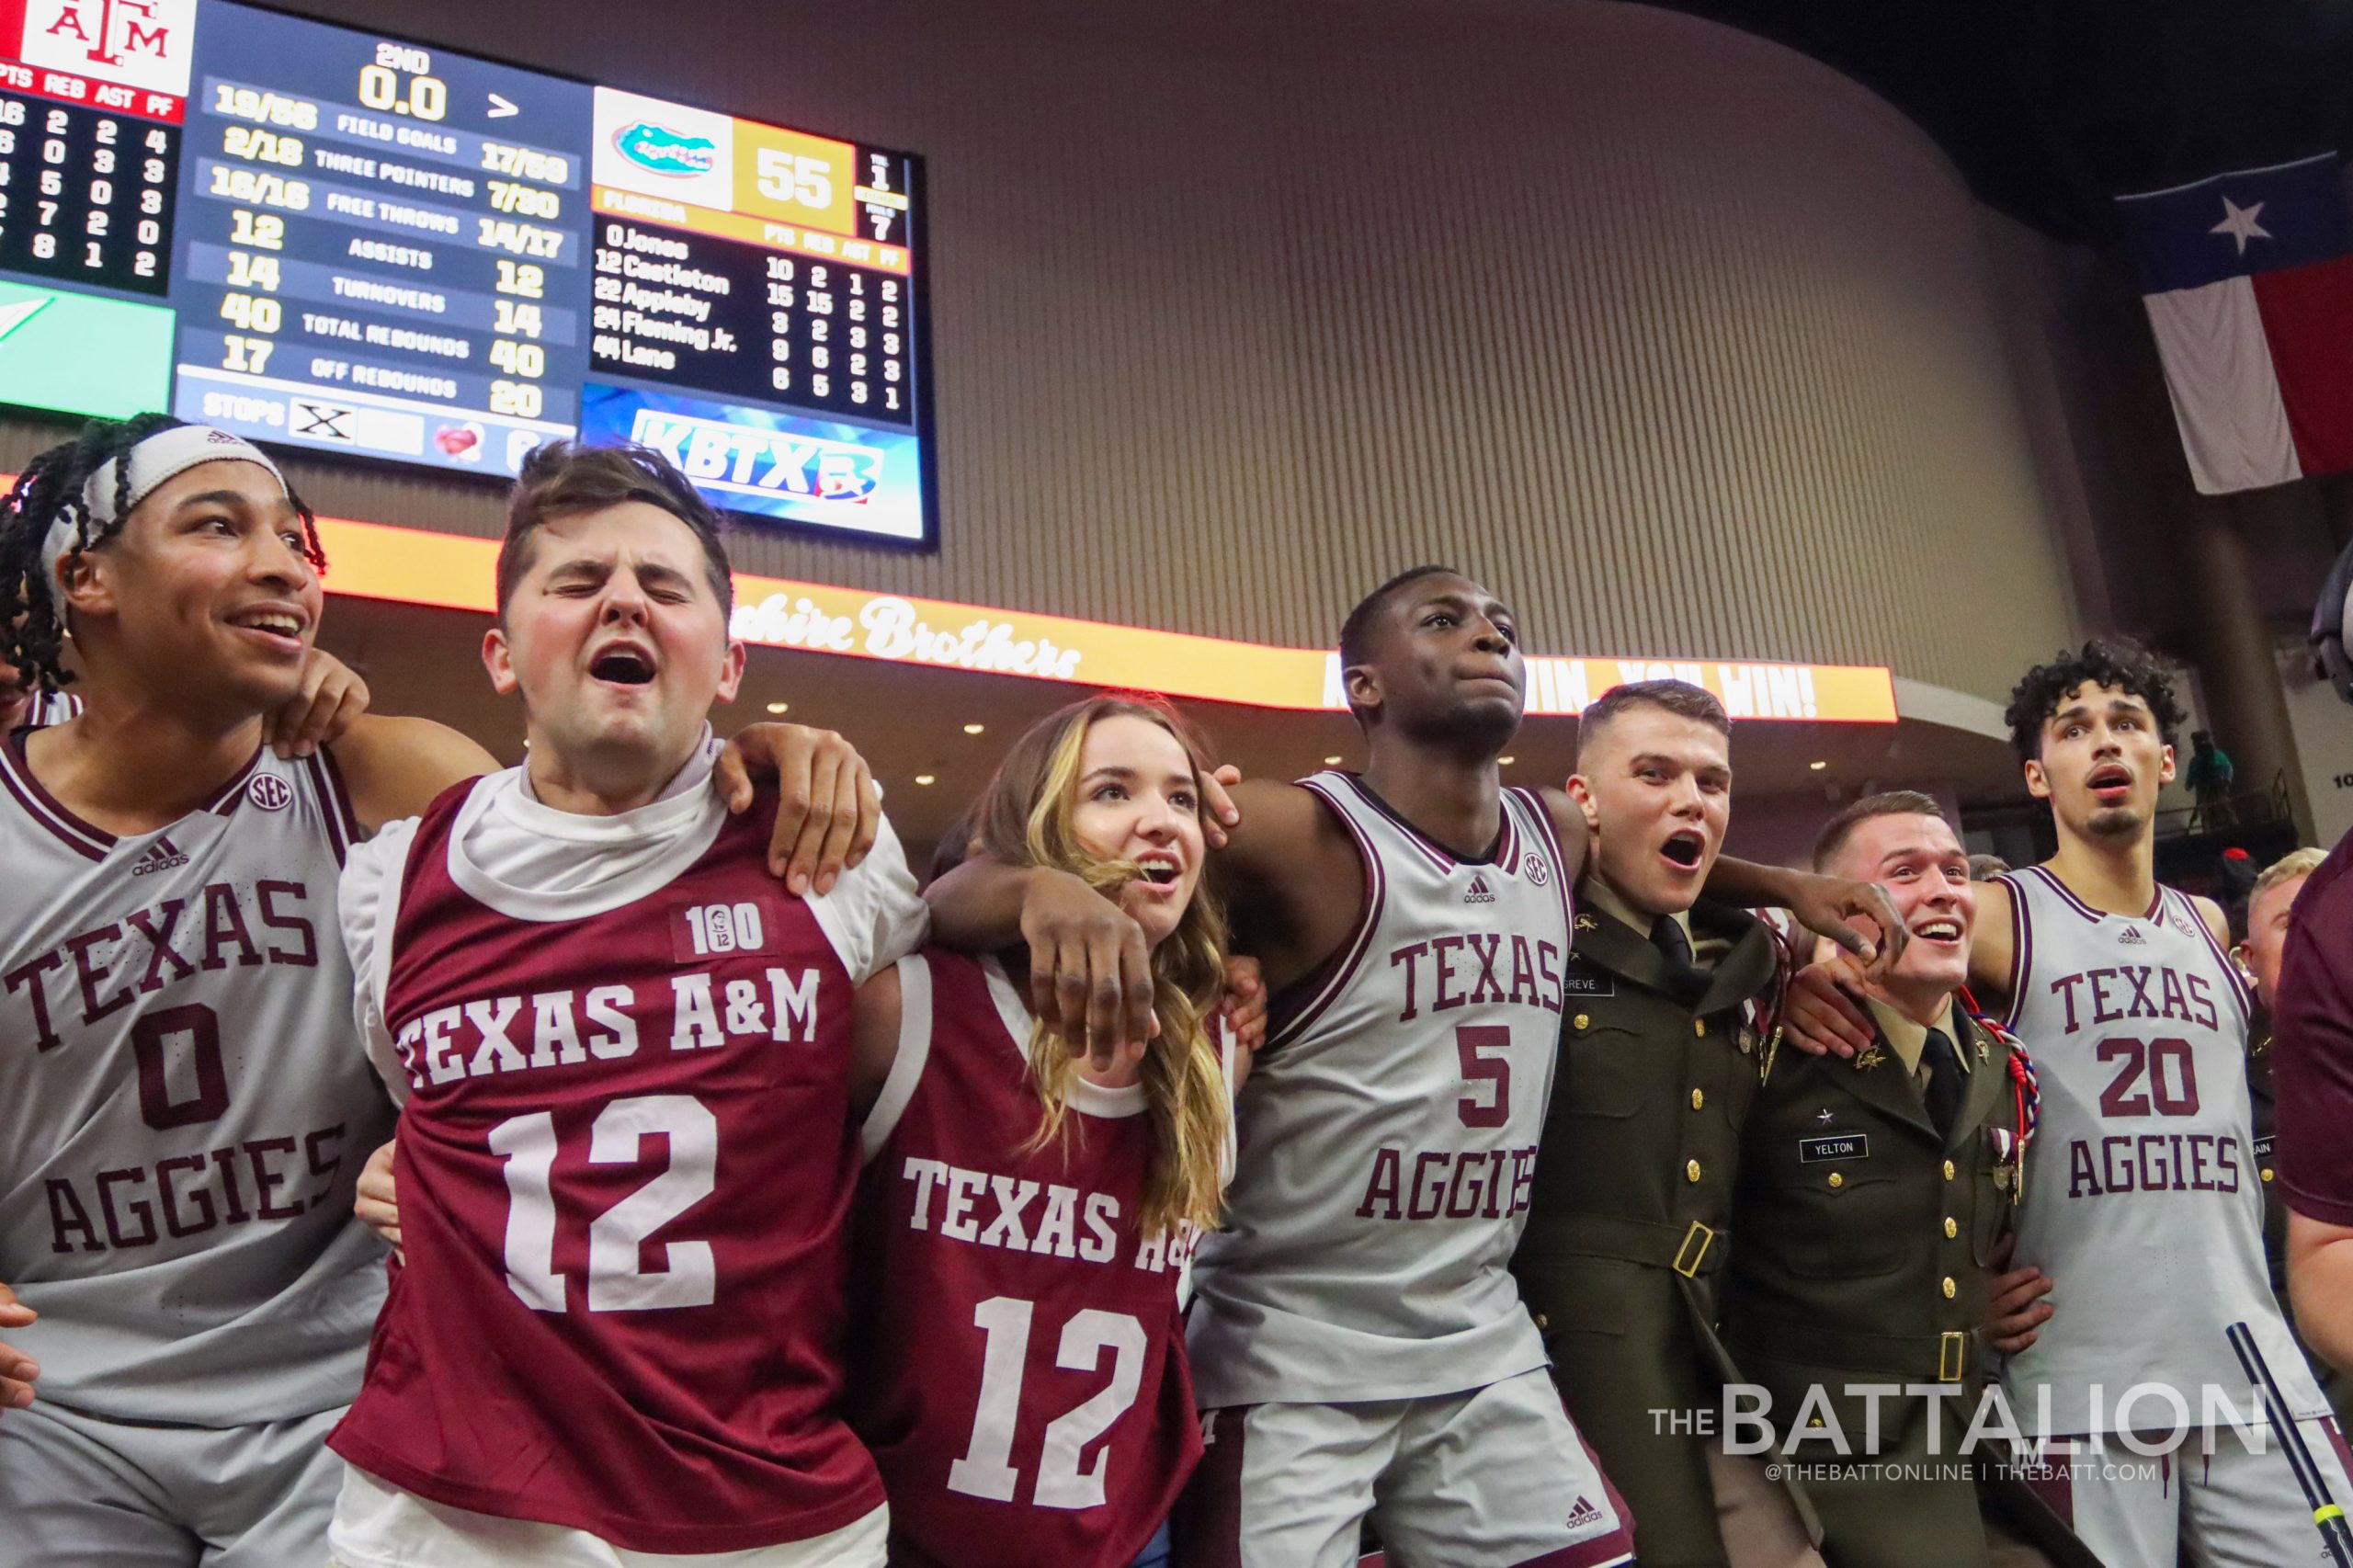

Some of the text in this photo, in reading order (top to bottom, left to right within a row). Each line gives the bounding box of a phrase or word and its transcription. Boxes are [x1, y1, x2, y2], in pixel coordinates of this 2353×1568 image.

[376, 43, 430, 74] 2ND
[44, 74, 86, 99] REB
[95, 85, 135, 108] AST
[146, 95, 174, 116] PF
[358, 64, 447, 121] 0.0
[44, 140, 65, 164] 0
[94, 149, 115, 174] 3
[143, 158, 165, 183] 3
[47, 110, 68, 135] 2
[97, 119, 118, 144] 2
[145, 130, 167, 154] 4
[223, 126, 303, 166] 2/18
[314, 149, 377, 178] THREE
[380, 163, 474, 198] POINTERS
[336, 114, 394, 140] FIELD
[396, 126, 458, 154] GOALS
[40, 170, 62, 195] 5
[90, 180, 112, 205] 0
[141, 189, 162, 214] 3
[757, 147, 832, 210] 55
[871, 165, 890, 192] 1
[38, 200, 159, 244] 7 2 0
[231, 210, 544, 299] 12 ASSISTS 12
[326, 193, 375, 219] FREE
[378, 202, 459, 234] THROWS
[478, 218, 563, 258] 14/17
[764, 224, 795, 246] PTS
[841, 240, 870, 263] AST
[880, 247, 900, 267] PF
[870, 214, 892, 241] 7
[33, 233, 156, 277] 8 1 2
[607, 224, 898, 302] 0 Jones 10 2 1 2
[227, 251, 542, 339] 14 TURNOVERS 14
[594, 277, 622, 302] 22
[622, 282, 711, 323] Appleby
[812, 320, 827, 342] 2
[850, 326, 867, 349] 3
[883, 333, 900, 356] 3
[595, 249, 898, 328] 12 Castleton 15 15 2 2
[221, 292, 545, 379] 40 TOTAL REBOUNDS 40
[622, 311, 710, 351] Fleming
[710, 327, 737, 353] Jr.
[812, 346, 829, 369] 6
[850, 354, 867, 377] 2
[883, 359, 900, 381] 3
[222, 335, 542, 419] 17 OFF REBOUNDS 20
[593, 334, 900, 410] 44 Lane 6 5 3 1
[202, 392, 285, 427] STOPS
[642, 419, 821, 494] KBTX
[858, 595, 1082, 680] Brothers
[1717, 665, 1817, 719] WIN!
[253, 777, 290, 805] SEC
[132, 852, 190, 877] adidas
[1526, 856, 1548, 883] SEC
[1464, 892, 1495, 903] adidas
[3, 879, 319, 1053] TEXAS
[716, 934, 730, 948] 12
[2118, 936, 2147, 946] adidas
[1390, 933, 1563, 1022] TEXAS
[2051, 965, 2219, 1035] TEXAS
[396, 969, 821, 1088] TEXAS A&M
[131, 1003, 230, 1131] 0
[1455, 1025, 1511, 1128] 5
[2097, 1037, 2200, 1118] 20
[1815, 1142, 1853, 1155] YELTON
[2068, 1134, 2239, 1199] AGGIES
[45, 1122, 347, 1254] AGGIES
[488, 1095, 717, 1312] 12
[903, 1156, 1120, 1264] TEXAS
[947, 1295, 1148, 1510] 12
[1566, 1509, 1603, 1529] adidas
